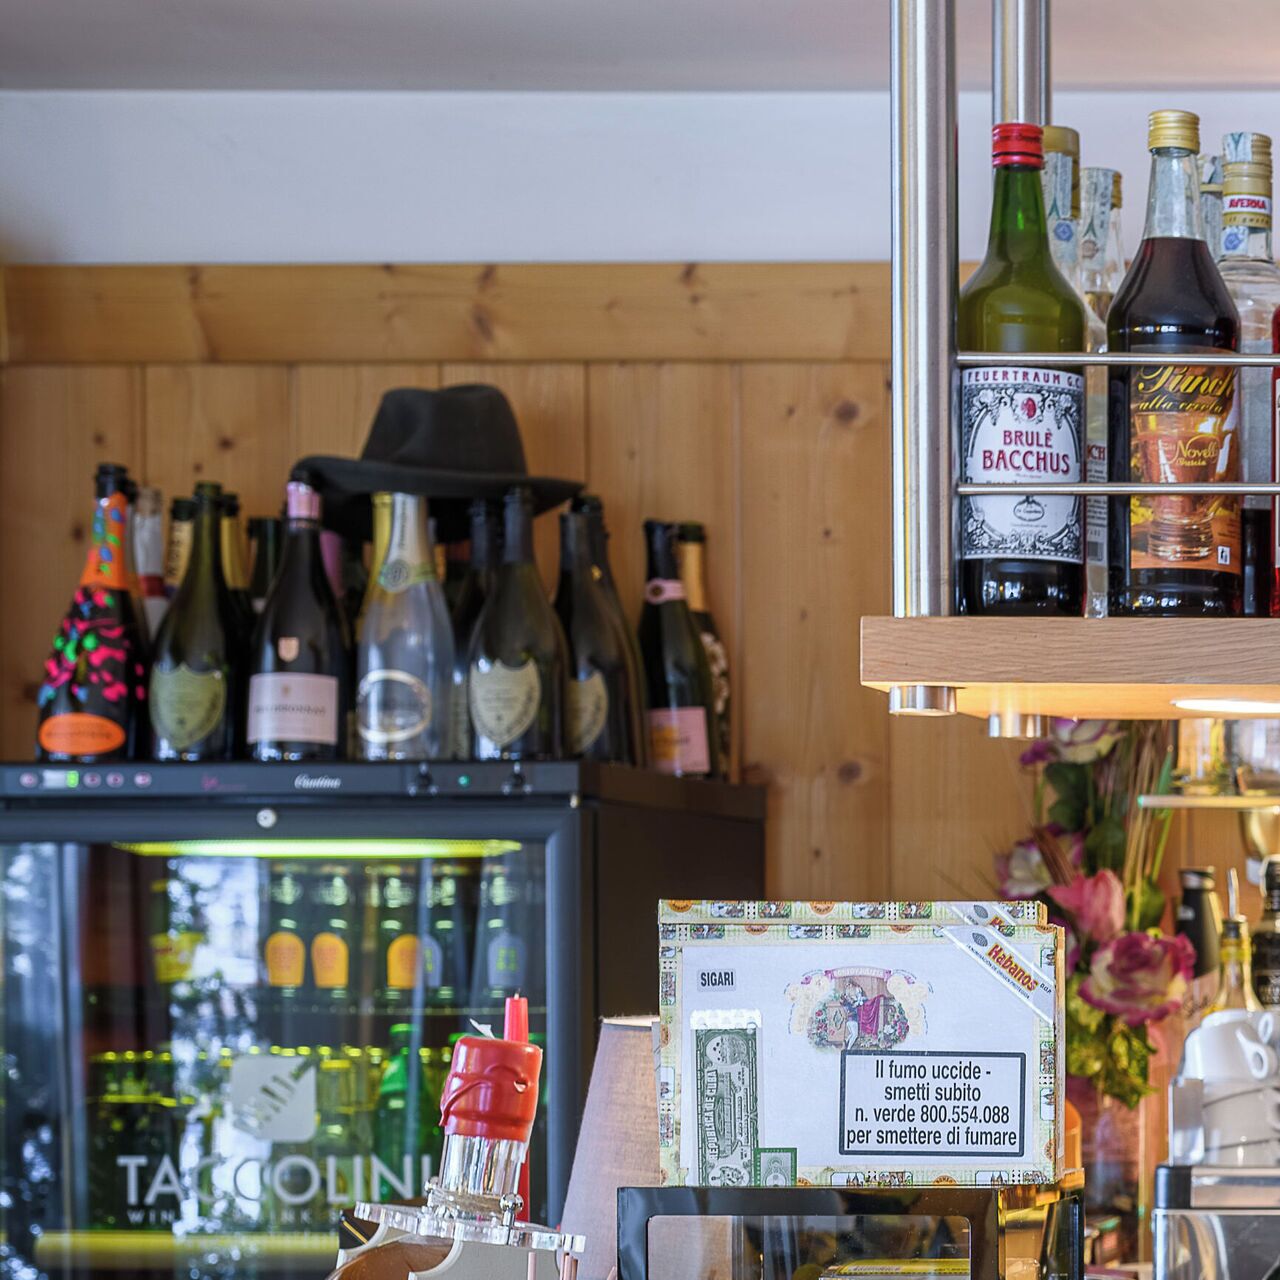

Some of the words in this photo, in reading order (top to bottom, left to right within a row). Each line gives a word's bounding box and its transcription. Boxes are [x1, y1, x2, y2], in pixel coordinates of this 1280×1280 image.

[1002, 427, 1054, 448] BRULÈ
[982, 449, 1071, 474] BACCHUS
[987, 943, 1039, 992] Habanos
[700, 971, 735, 988] SIGARI
[876, 1060, 886, 1079] Il
[888, 1060, 927, 1079] fumo
[931, 1060, 982, 1080] uccide
[884, 1082, 932, 1101] smetti
[935, 1082, 982, 1102] subito
[855, 1108, 869, 1123] n.
[873, 1105, 916, 1123] verde
[920, 1105, 1010, 1123] 800.554.088
[847, 1130, 871, 1149] per
[874, 1126, 942, 1145] smettere
[946, 1126, 961, 1145] di
[964, 1127, 1018, 1146] fumare
